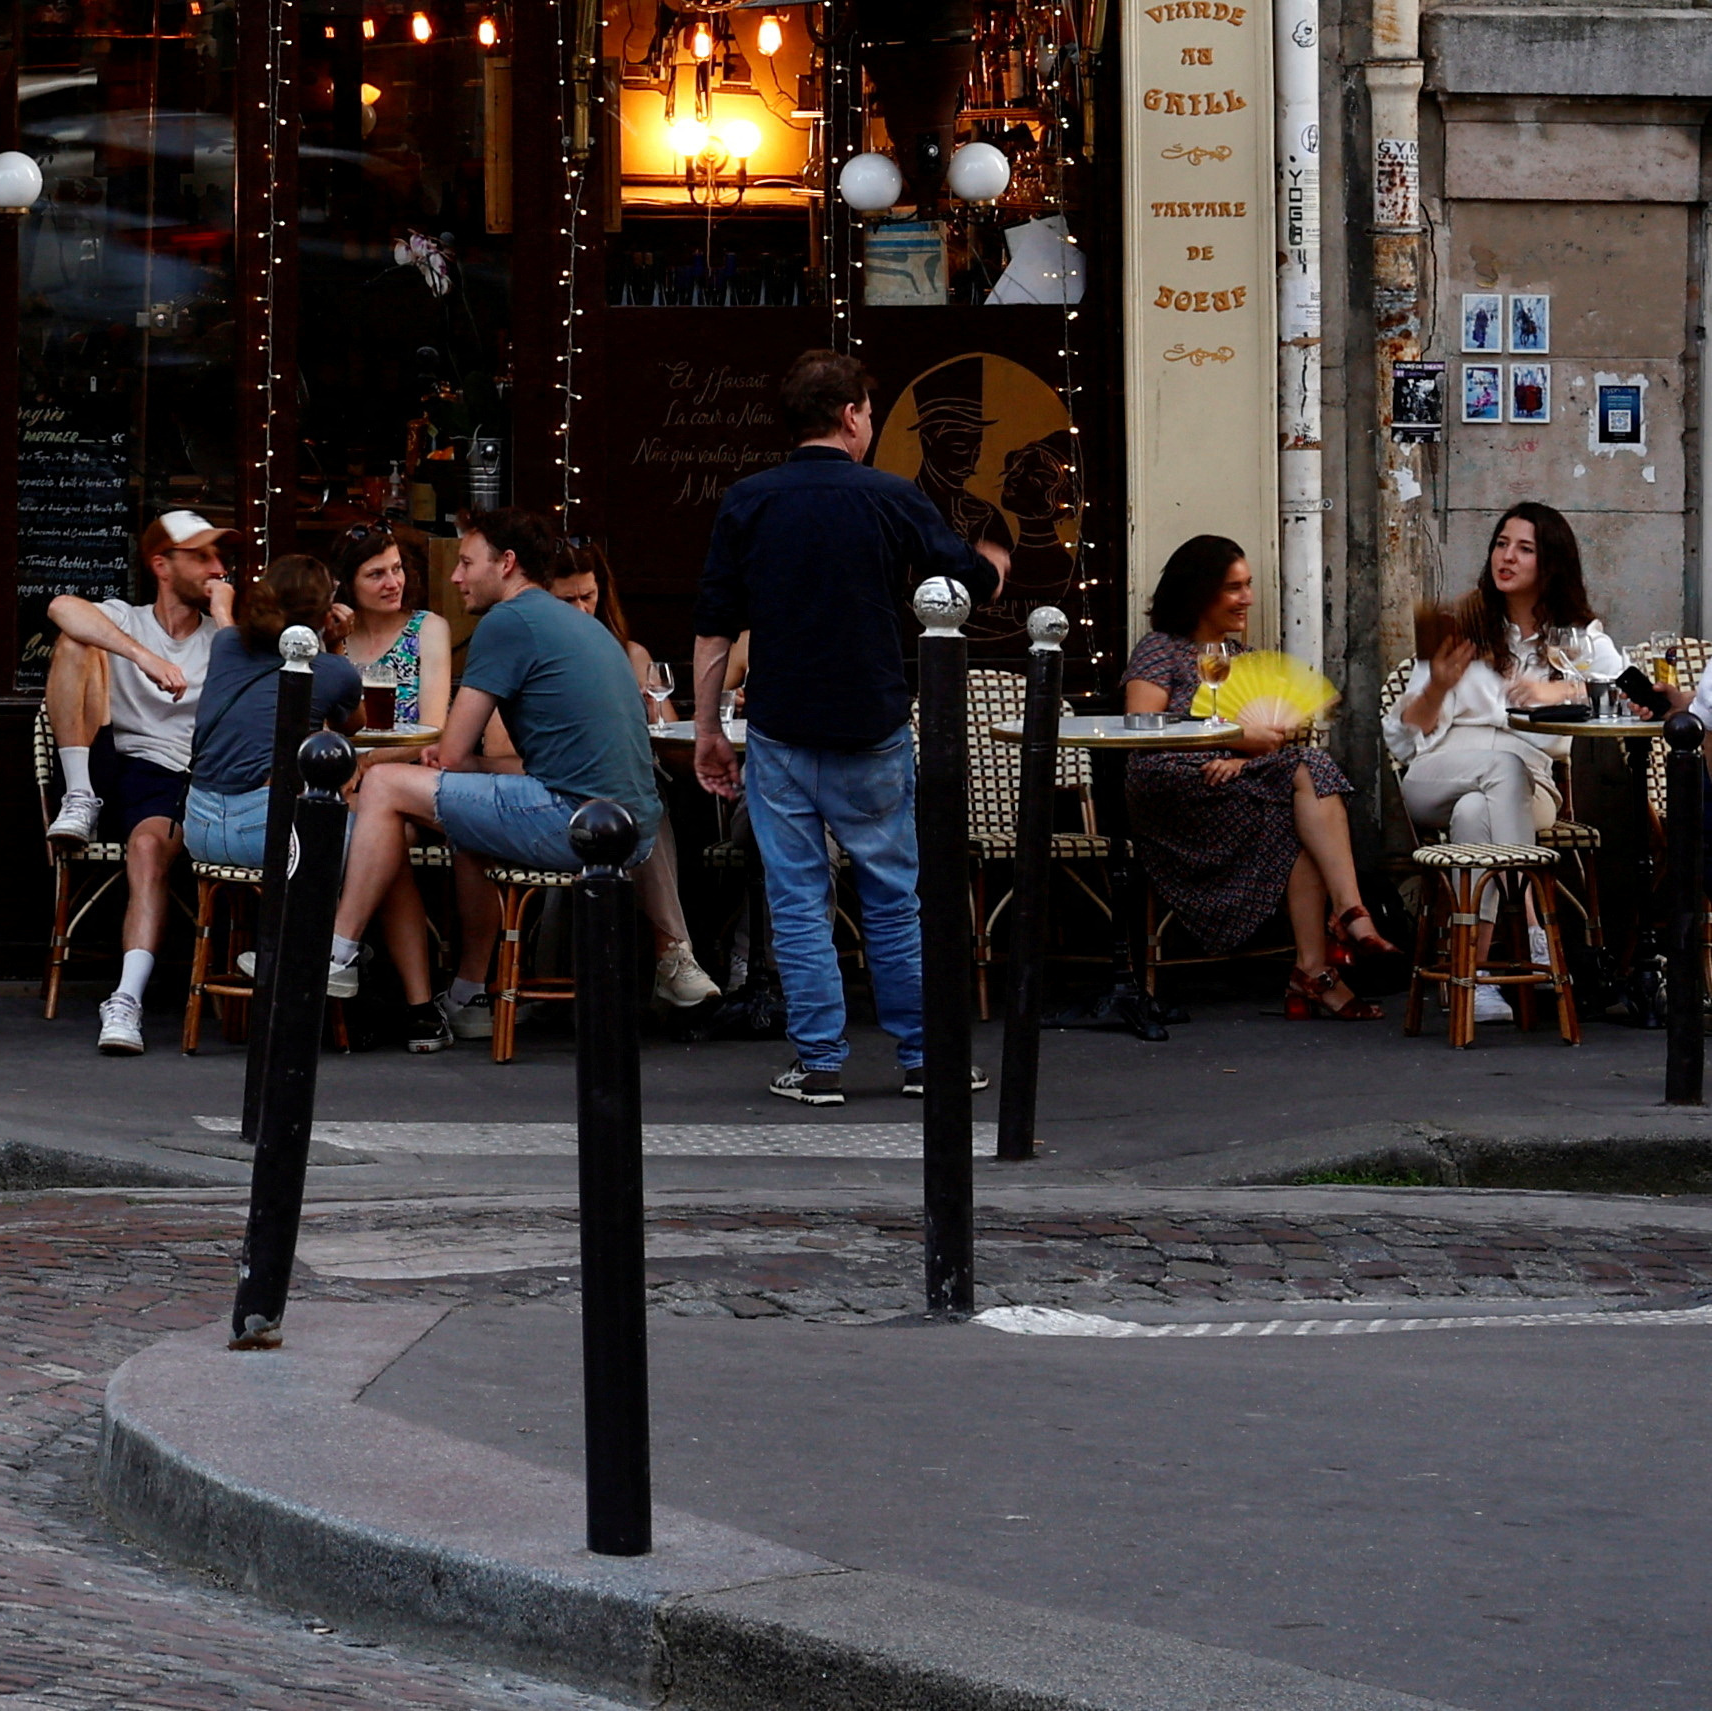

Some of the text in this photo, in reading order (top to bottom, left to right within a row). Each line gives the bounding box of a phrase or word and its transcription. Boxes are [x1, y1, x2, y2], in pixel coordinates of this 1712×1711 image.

[1144, 0, 1248, 27] VIANDE
[1180, 47, 1214, 65] AU
[1143, 88, 1248, 116] GRILL
[1151, 201, 1248, 218] TARTARE
[1186, 245, 1215, 261] DE
[22, 430, 80, 443] PARTAGER
